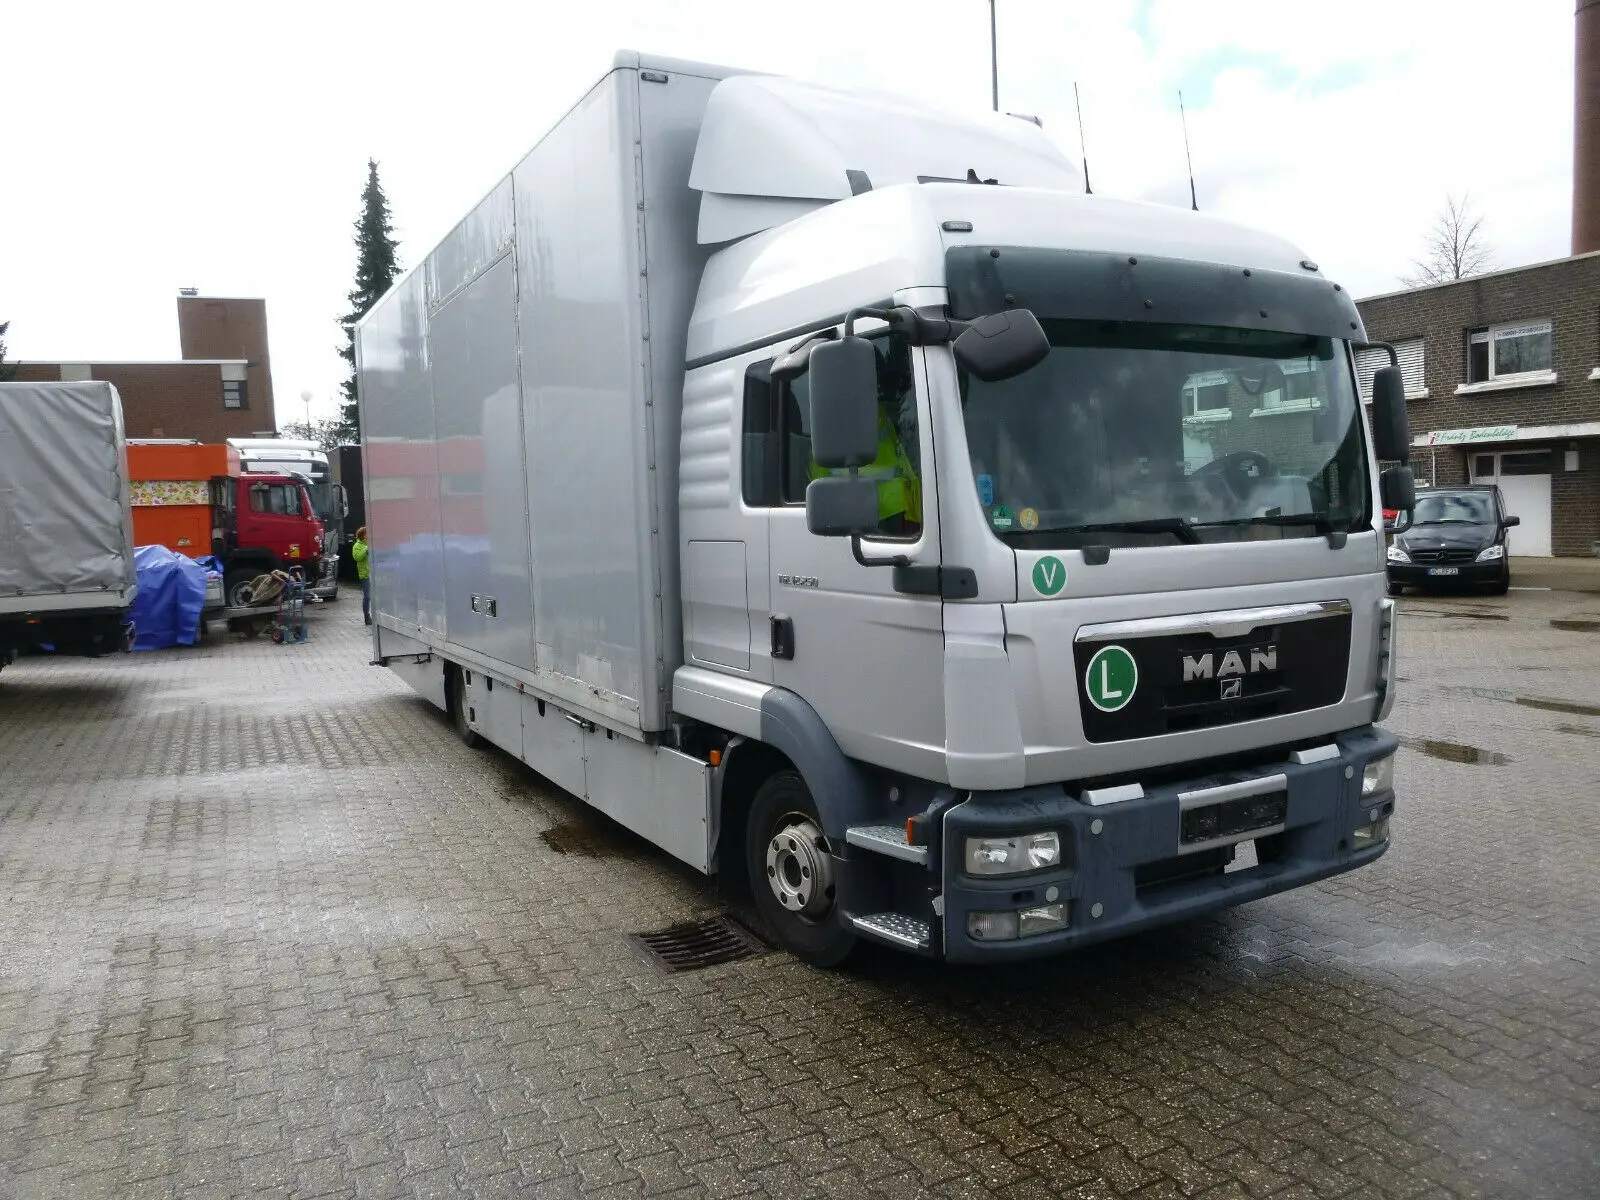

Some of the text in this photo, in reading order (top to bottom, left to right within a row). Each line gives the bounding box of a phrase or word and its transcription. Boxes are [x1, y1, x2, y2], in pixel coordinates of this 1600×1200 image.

[1040, 563, 1057, 589] V
[1101, 659, 1123, 700] L
[1182, 645, 1277, 682] MAN
